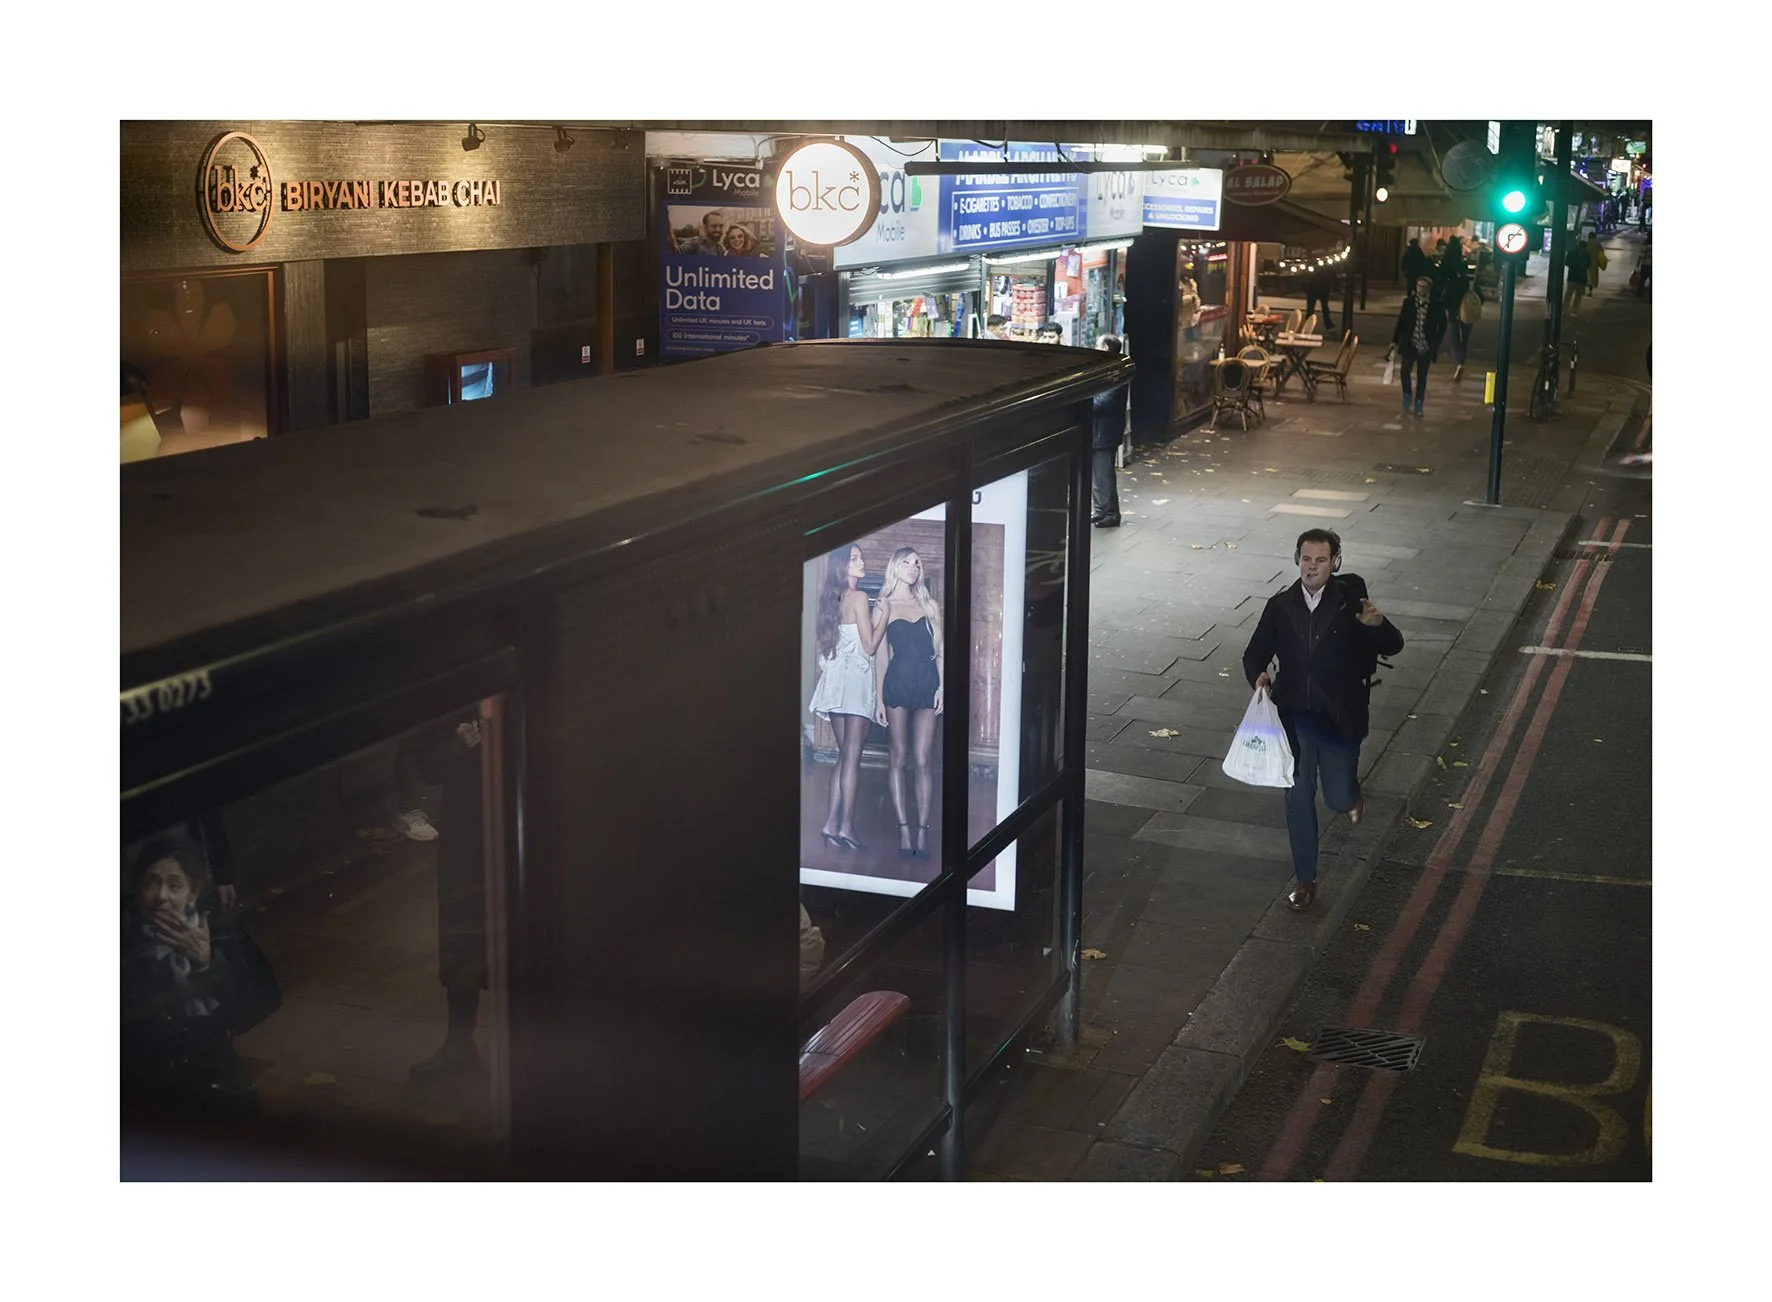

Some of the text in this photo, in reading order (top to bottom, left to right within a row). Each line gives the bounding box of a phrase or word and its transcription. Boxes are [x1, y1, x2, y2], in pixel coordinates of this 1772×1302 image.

[713, 169, 760, 190] Lyca
[1151, 170, 1188, 187] Lyca
[284, 180, 501, 211] BIRYANI KEBAB CHAI
[733, 188, 760, 197] Mobile
[960, 195, 1000, 214] E-CIGARETTES
[1006, 194, 1033, 211] TOBACCO
[876, 220, 905, 242] Mobile
[958, 223, 982, 241] DRINKS
[989, 221, 1001, 238] BUS
[1001, 220, 1021, 237] PASSES
[666, 265, 774, 290] Unlimited
[666, 288, 721, 311] Data
[671, 316, 698, 324] Unlimited
[684, 332, 722, 341] International
[1452, 1010, 1652, 1168] B
